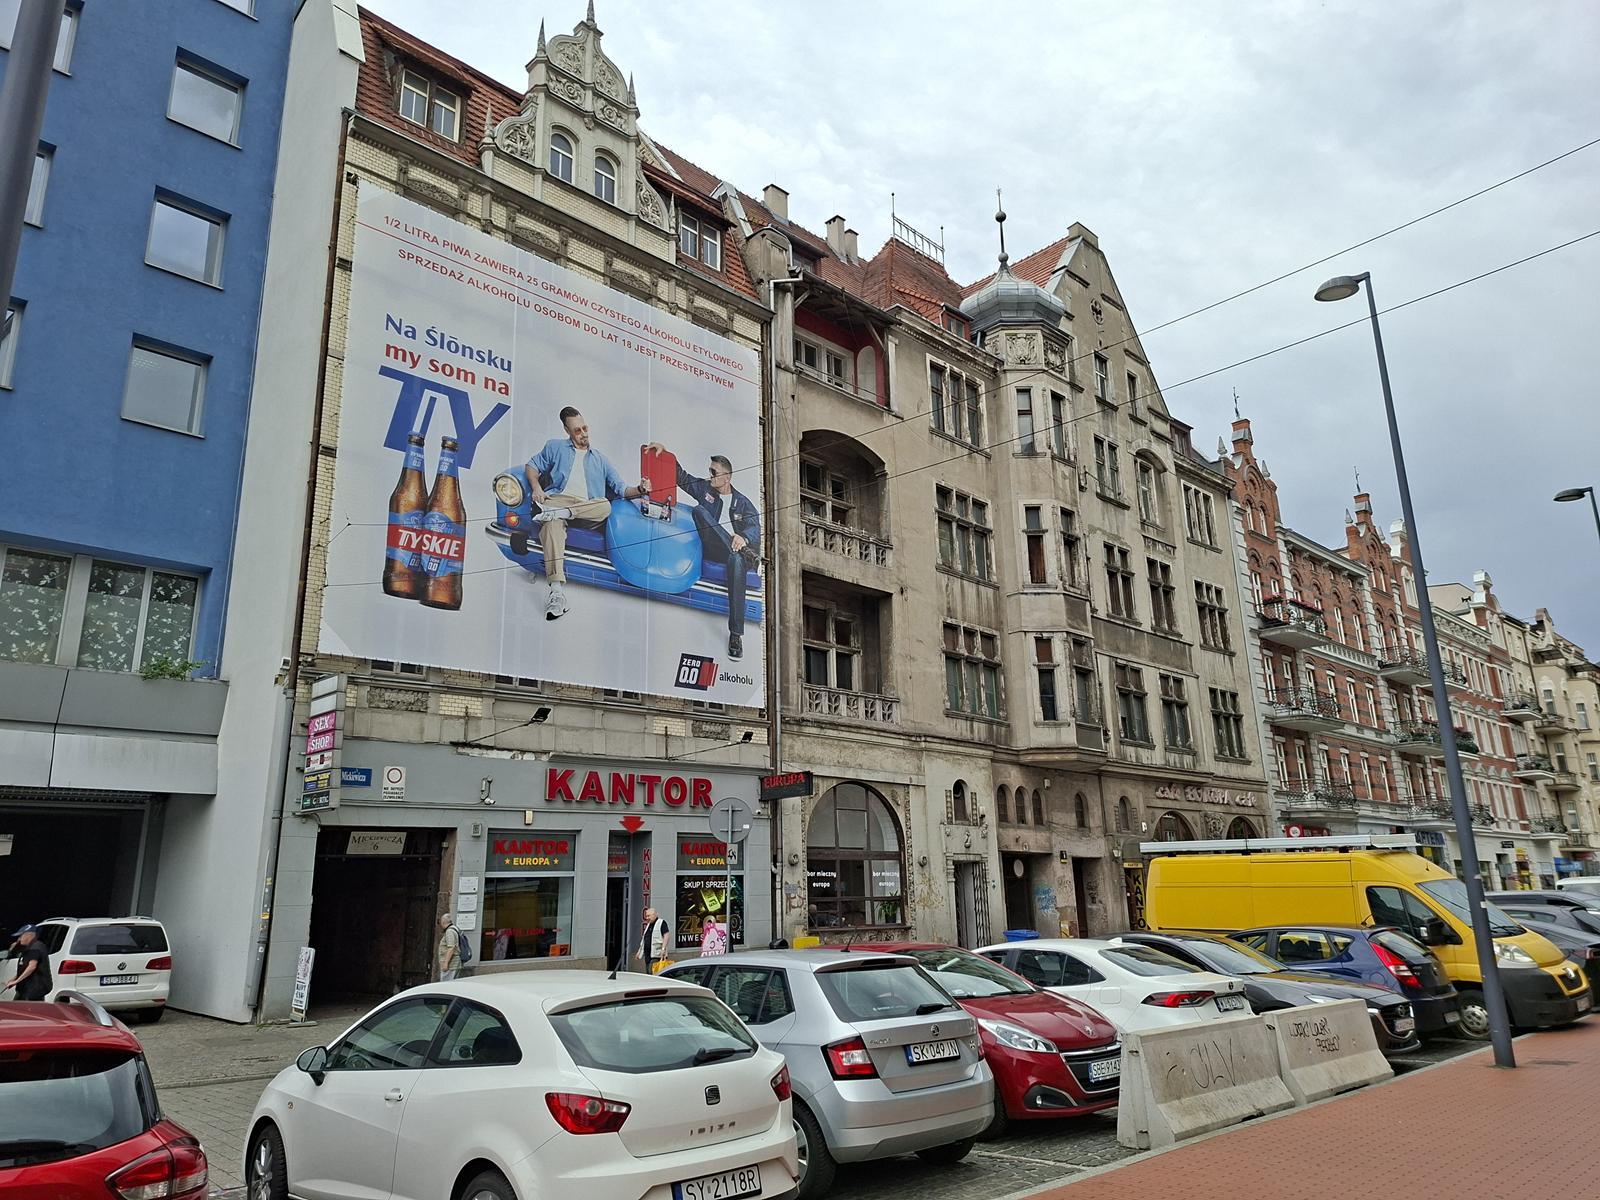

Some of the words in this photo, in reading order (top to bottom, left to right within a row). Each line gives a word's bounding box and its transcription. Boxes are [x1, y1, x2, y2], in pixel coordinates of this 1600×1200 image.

[384, 215, 400, 229] 1/2
[404, 223, 439, 246] LITRA
[443, 239, 472, 258] PIWA
[474, 252, 525, 280] ZAWIERA
[526, 275, 539, 287] 25
[541, 281, 588, 307] GRAMÓW
[591, 302, 641, 329] CZYSTEGO
[643, 323, 690, 350] ALKOHOLU
[693, 344, 744, 371] ETYLOWEGO
[398, 248, 465, 283] SPRZEDAŻ
[467, 277, 531, 309] ALKOHOLU
[534, 303, 581, 329] OSOBOM
[584, 322, 598, 335] DO
[601, 330, 619, 343] LAT
[622, 339, 632, 349] 18
[634, 344, 657, 359] JEST
[660, 353, 734, 389] PRZESTĘPSTWEM
[385, 313, 417, 341] Na
[385, 343, 422, 369] my
[428, 358, 476, 385] som
[484, 375, 510, 396] na
[378, 365, 511, 470] TY
[398, 529, 462, 557] TYSKIE
[682, 658, 701, 667] ZERO
[719, 672, 753, 685] alkoholu
[314, 716, 330, 732] SEX
[311, 735, 330, 751] SHOP
[545, 768, 715, 808] KANTOR
[763, 773, 806, 789] EUROPA
[351, 835, 403, 845] MICKIEWICZA
[372, 842, 379, 851] 6
[494, 839, 569, 855] KANTOR
[681, 842, 728, 856] KANTO
[513, 857, 550, 866] EUROPA
[684, 881, 701, 889] SKUP
[1133, 875, 1146, 929] KANTO
[912, 1045, 929, 1061] SK
[1093, 1062, 1106, 1077] SBE
[711, 1169, 757, 1198] 2118R
